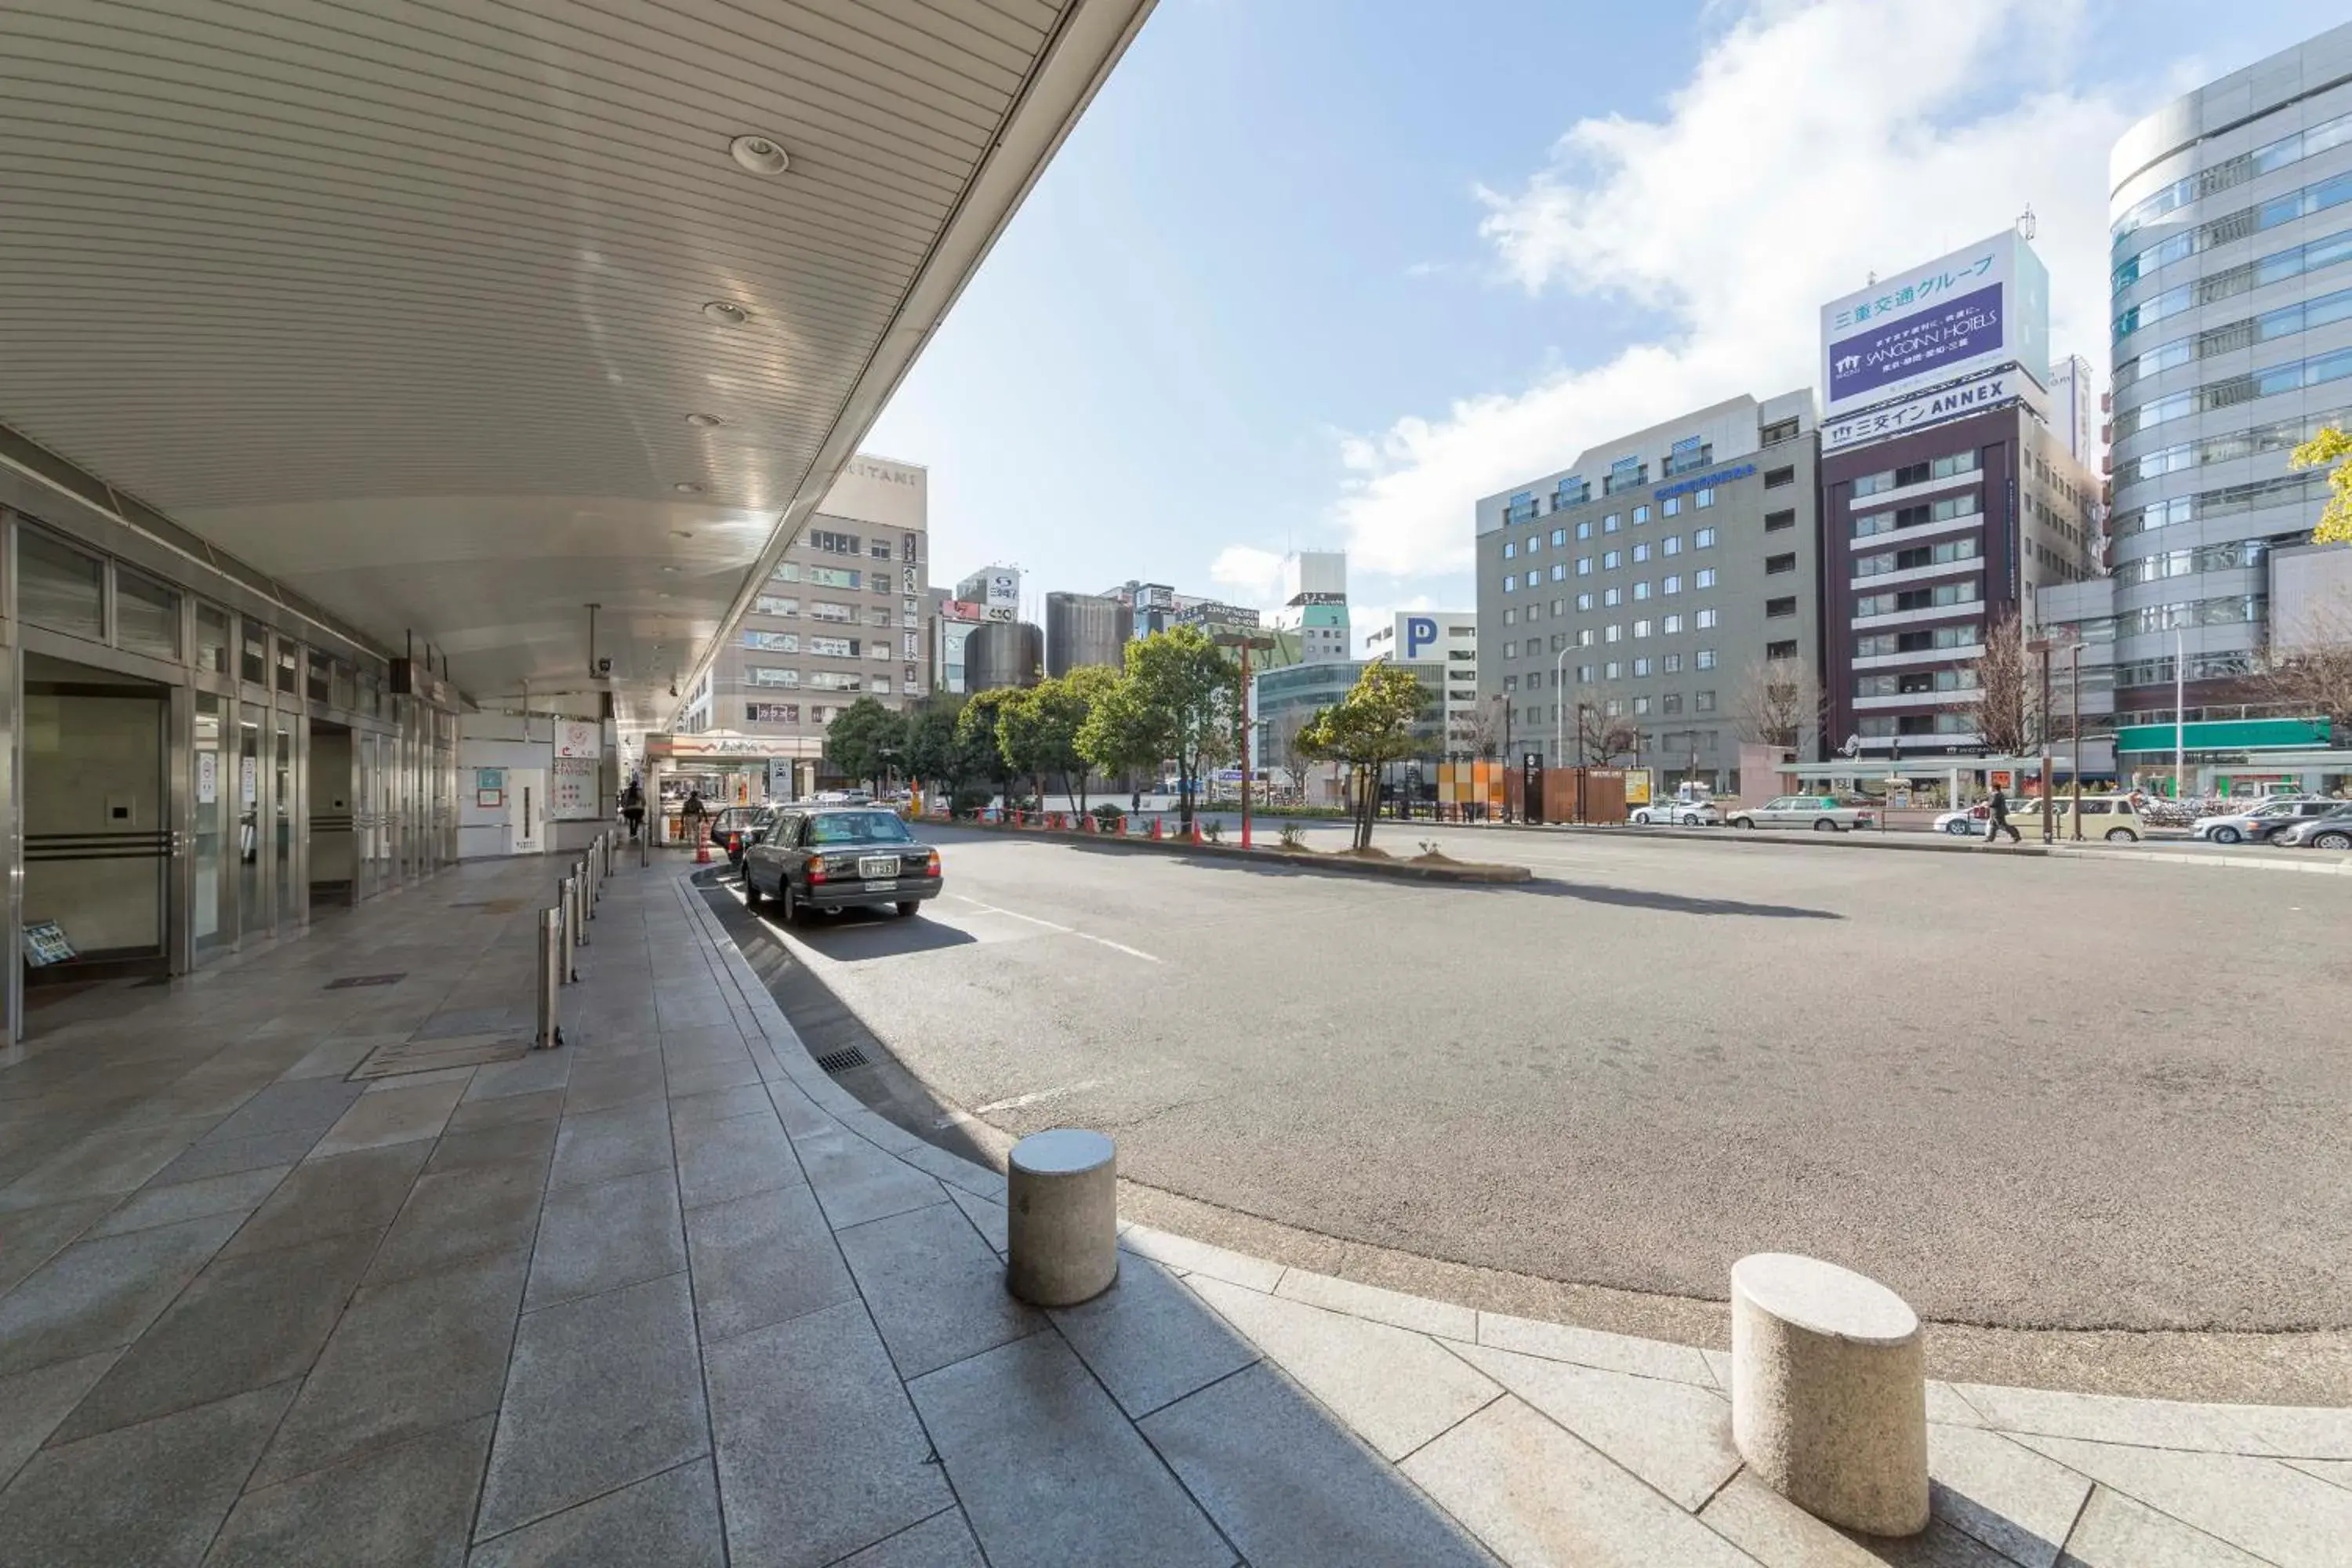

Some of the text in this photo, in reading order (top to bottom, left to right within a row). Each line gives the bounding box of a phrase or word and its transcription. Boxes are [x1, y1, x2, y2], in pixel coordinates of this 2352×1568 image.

[1834, 253, 1996, 331] 三重交通グループ
[1944, 310, 1998, 339] HOTELS
[1856, 380, 2004, 437] 三交イン ANNEX
[1406, 617, 1438, 659] P
